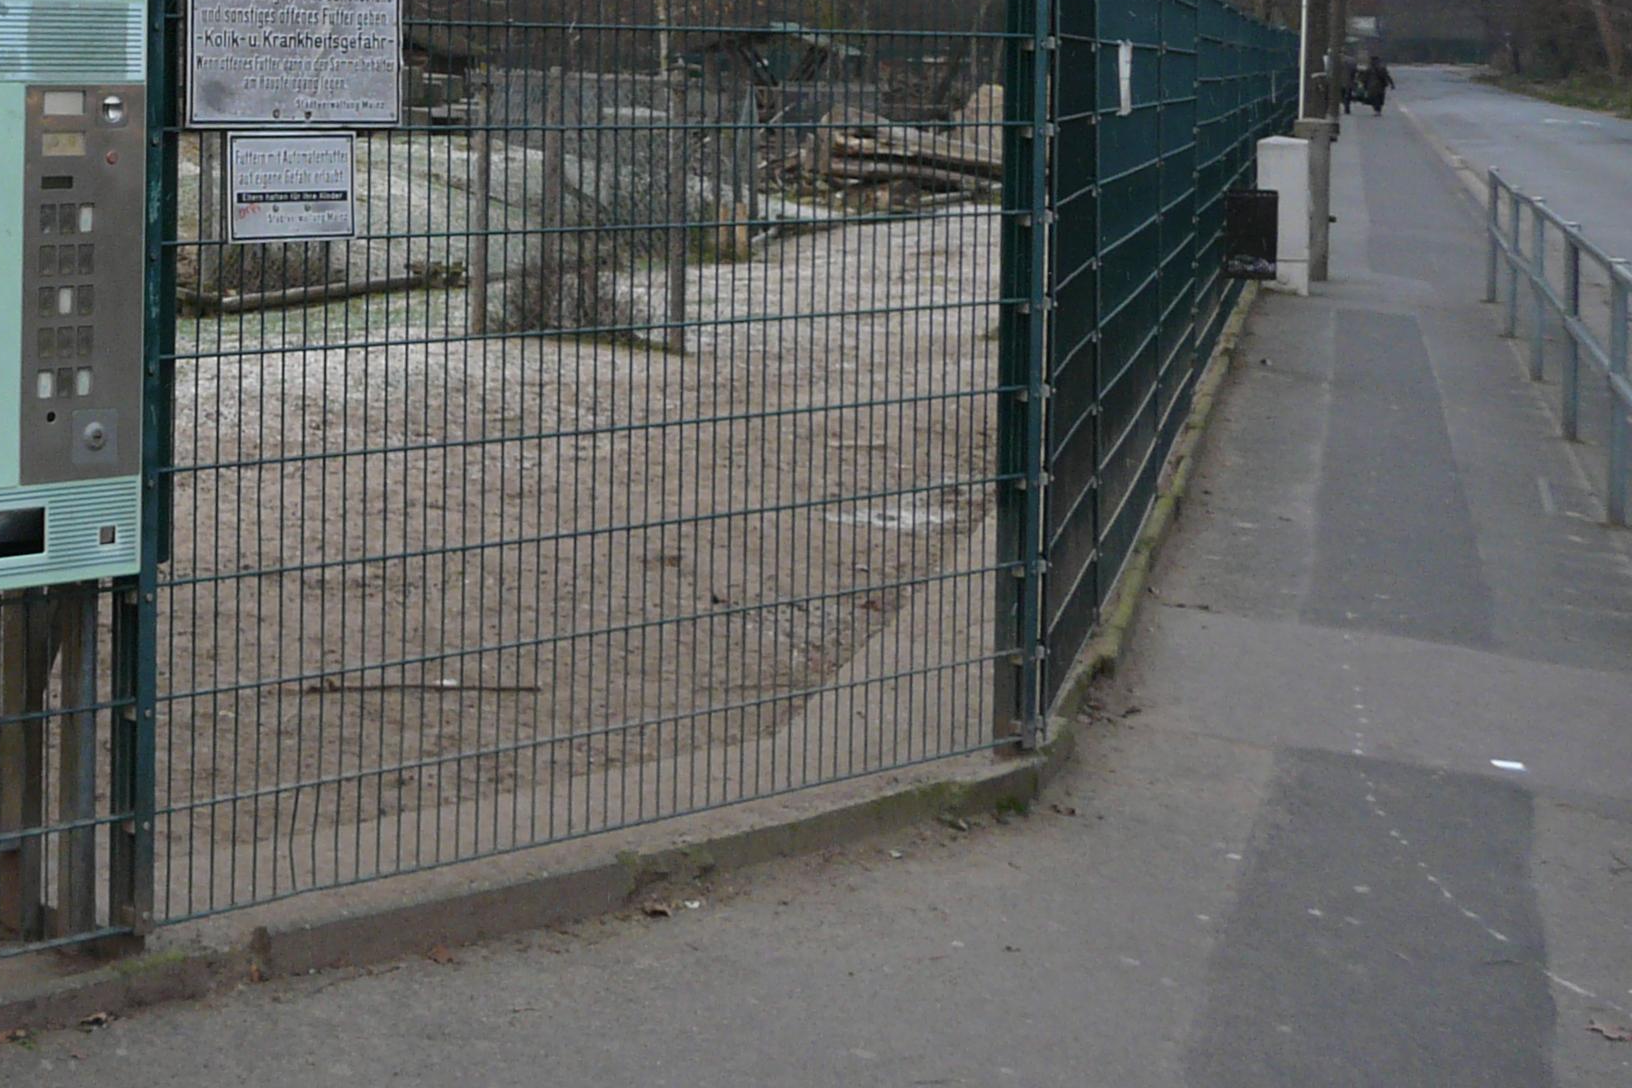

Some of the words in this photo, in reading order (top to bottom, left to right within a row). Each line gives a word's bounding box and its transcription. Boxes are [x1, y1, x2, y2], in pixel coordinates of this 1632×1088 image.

[201, 5, 221, 23] und
[224, 7, 276, 29] sonstiges
[279, 6, 318, 24] offenes
[322, 8, 354, 25] Futter
